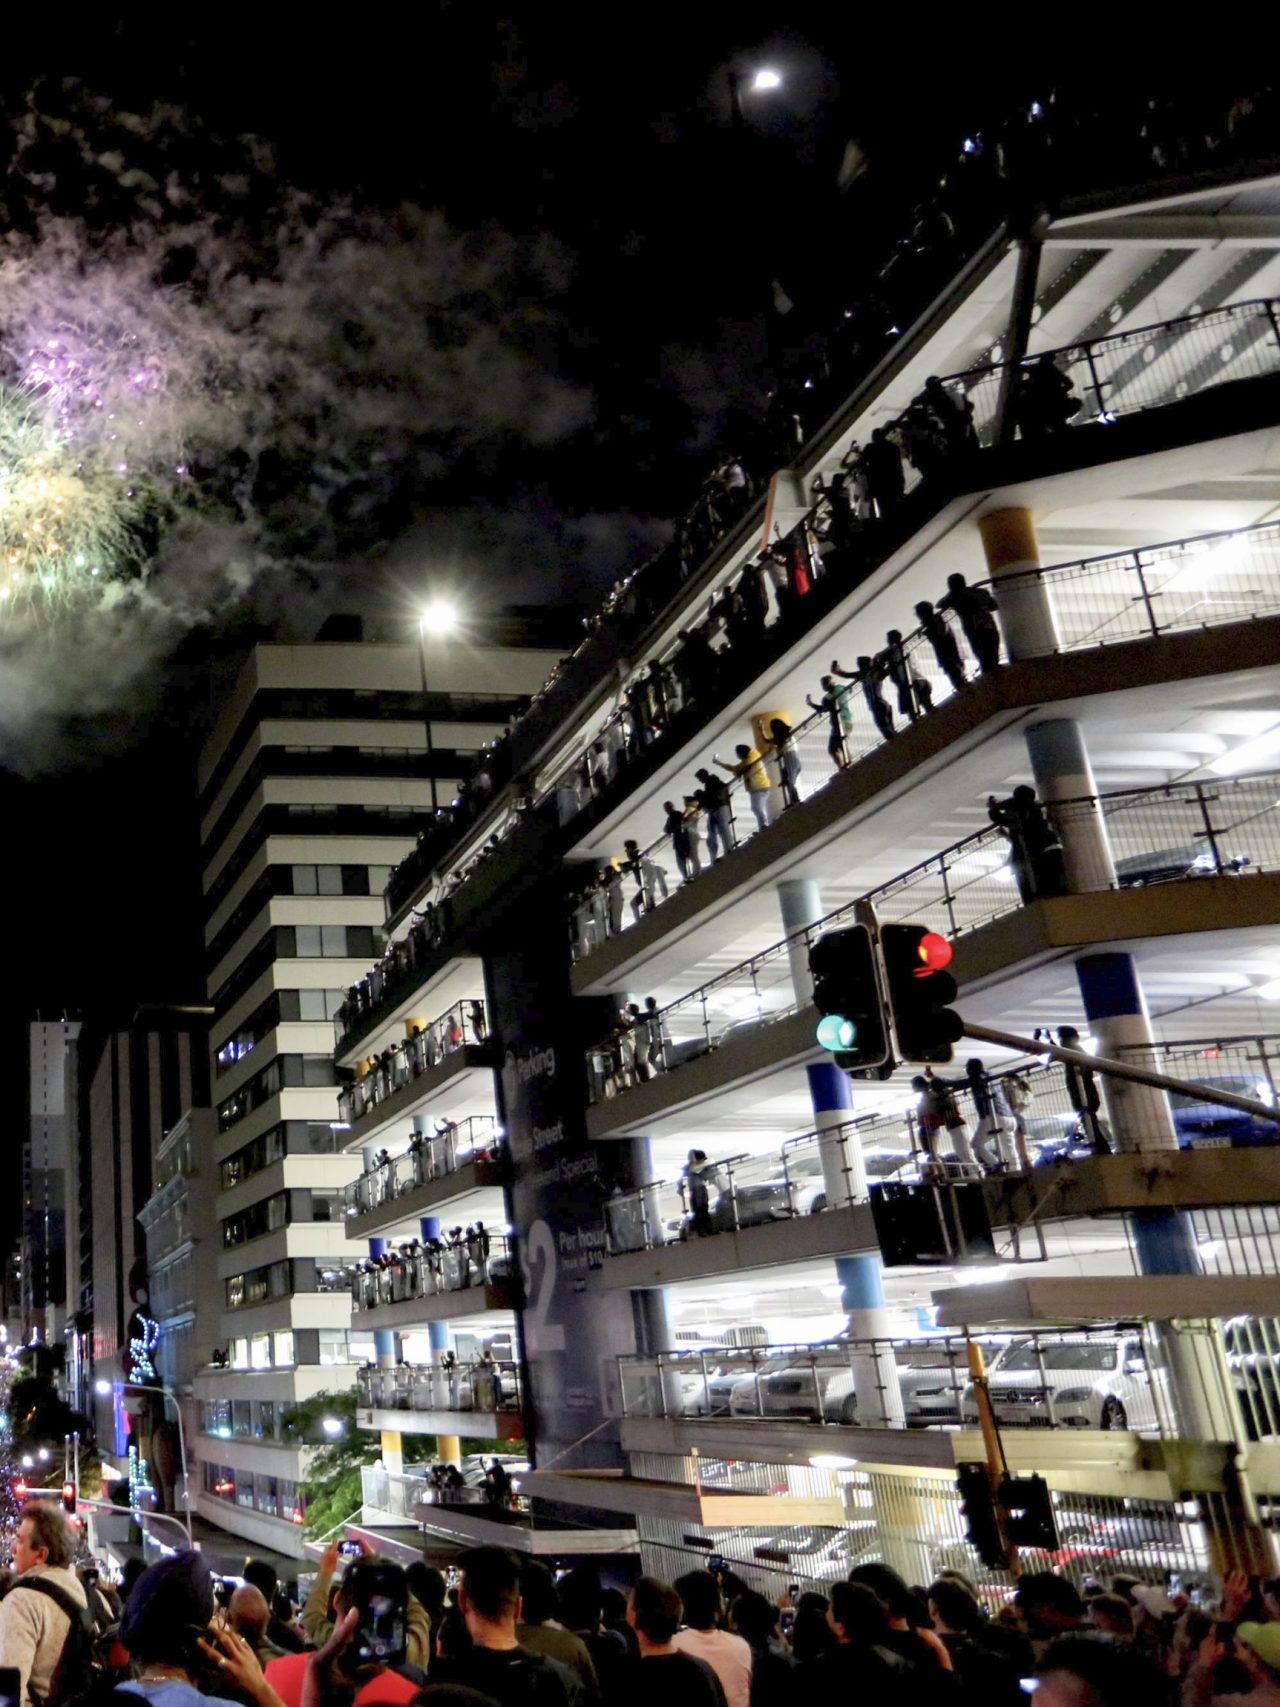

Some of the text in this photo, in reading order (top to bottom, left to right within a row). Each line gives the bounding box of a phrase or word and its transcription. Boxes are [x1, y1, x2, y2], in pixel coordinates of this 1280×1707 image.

[516, 1046, 555, 1081] Parking
[533, 1121, 565, 1150] Street
[560, 1147, 598, 1183] Special
